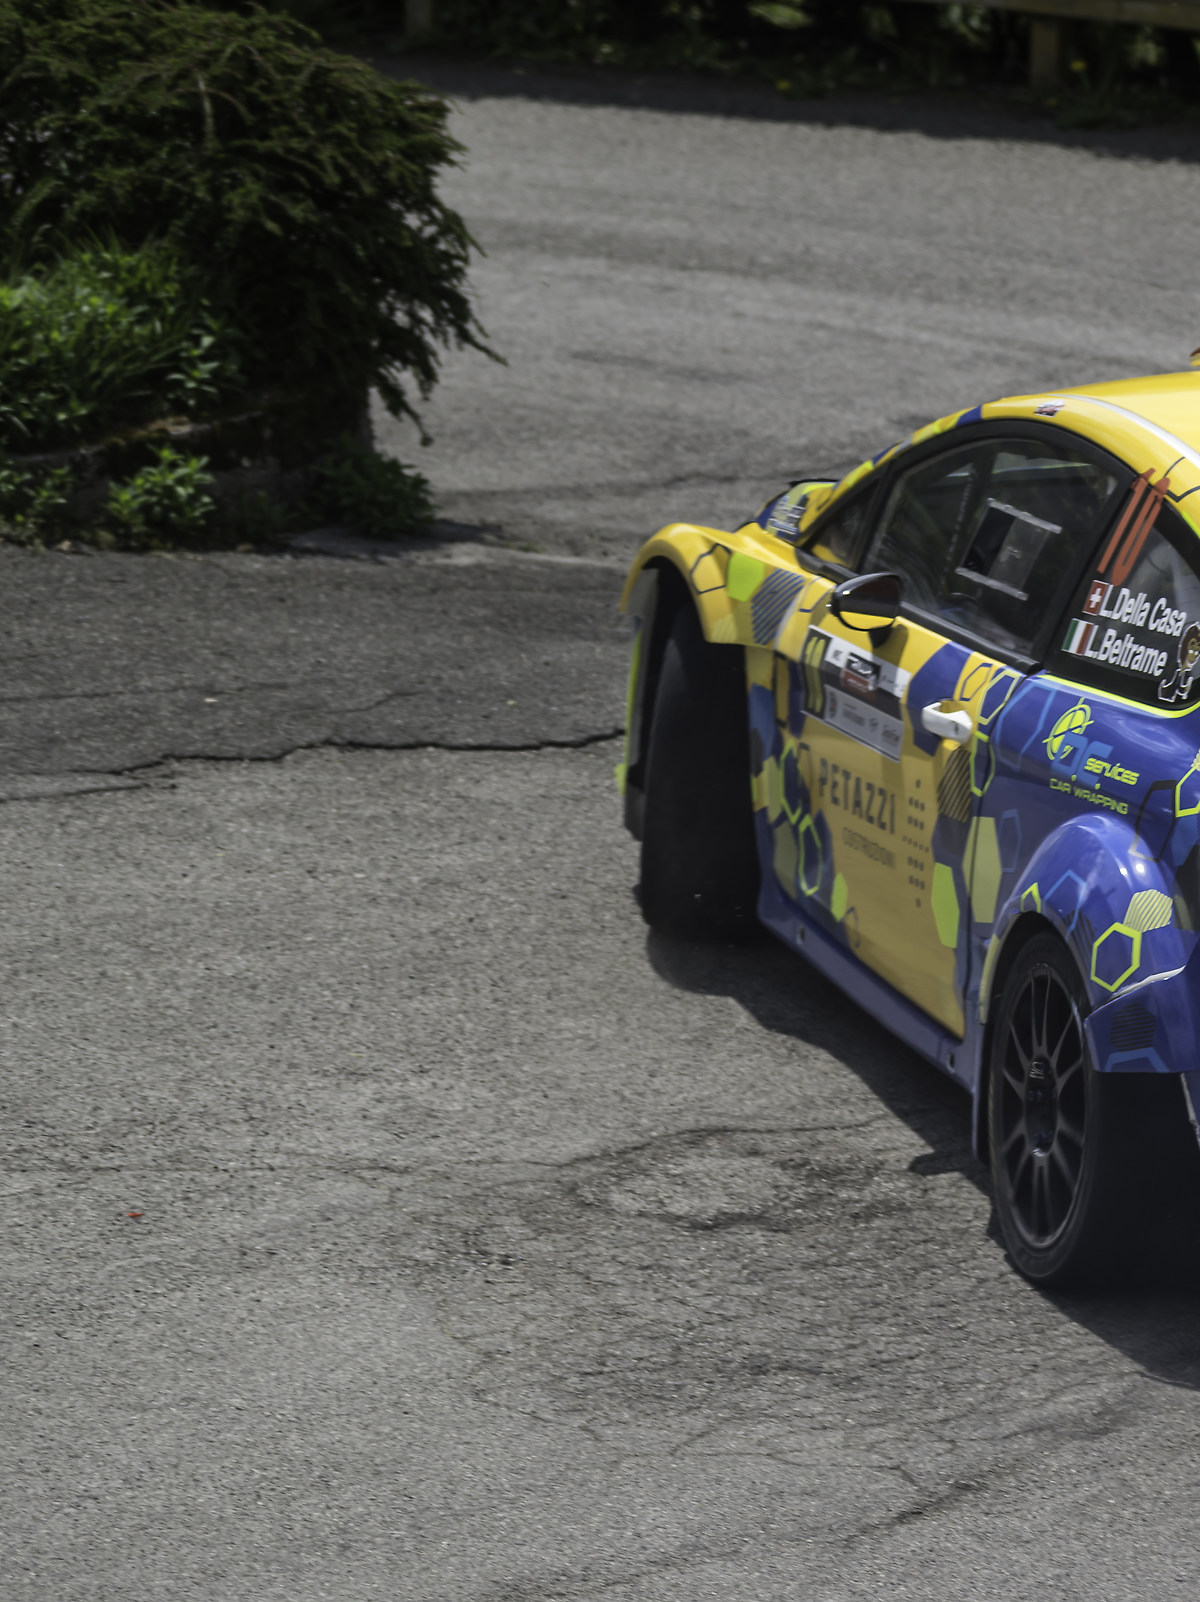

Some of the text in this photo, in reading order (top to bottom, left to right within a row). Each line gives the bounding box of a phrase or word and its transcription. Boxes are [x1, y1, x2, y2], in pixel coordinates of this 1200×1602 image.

[1097, 467, 1170, 586] 10
[1097, 584, 1187, 636] L.Della Casa
[1085, 624, 1168, 676] L.Beltrame
[818, 757, 896, 834] PETAZZI
[1049, 777, 1129, 815] CAR WRAPPING
[1083, 758, 1140, 786] services
